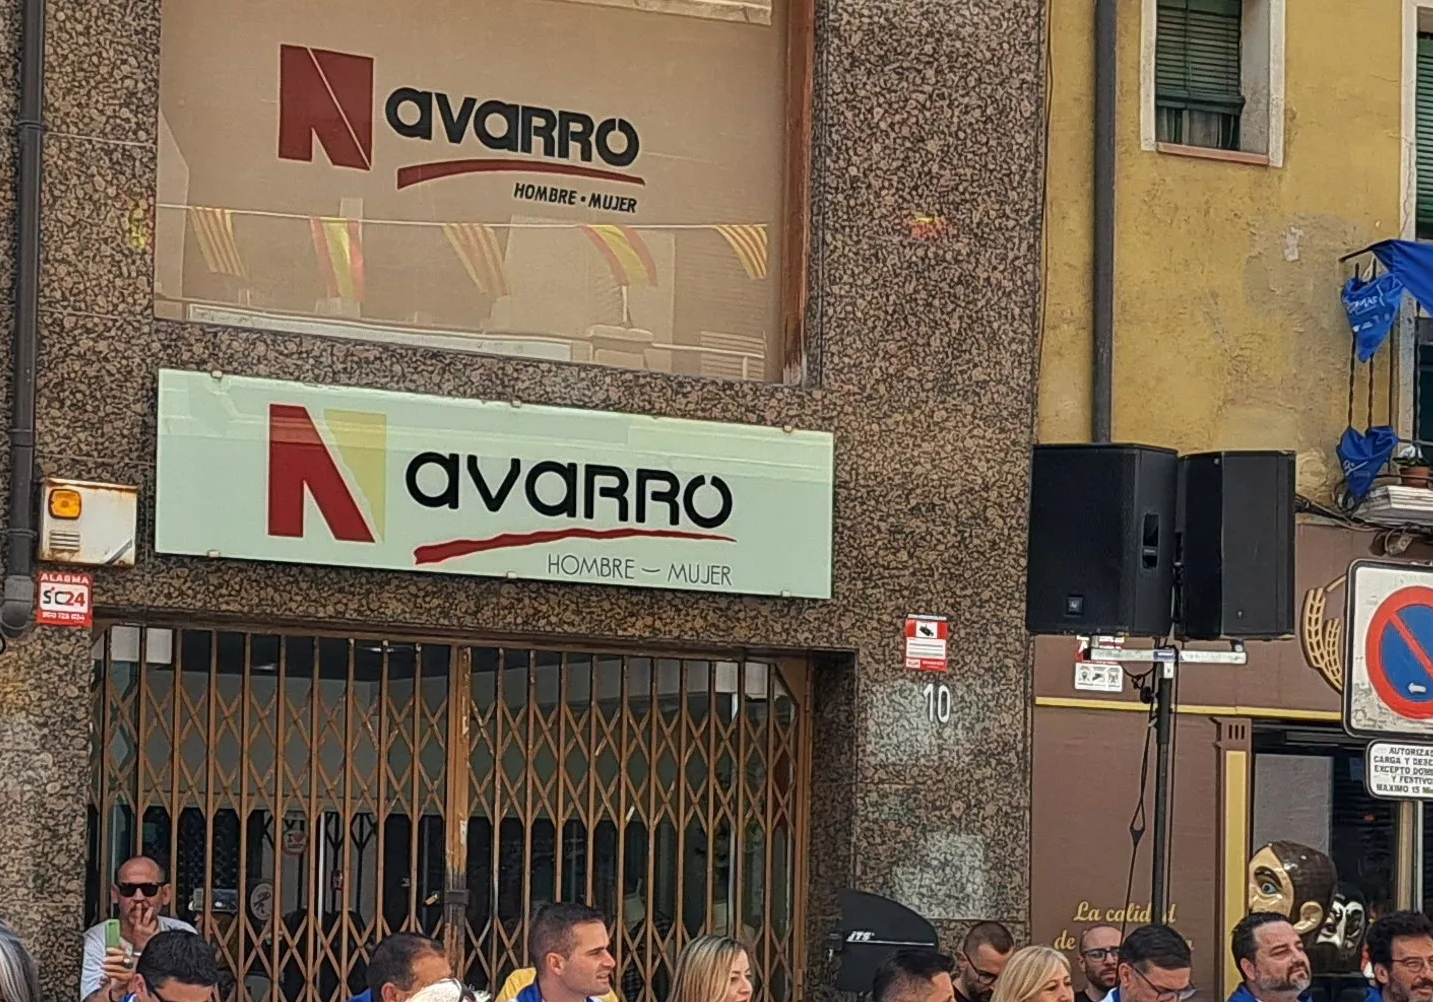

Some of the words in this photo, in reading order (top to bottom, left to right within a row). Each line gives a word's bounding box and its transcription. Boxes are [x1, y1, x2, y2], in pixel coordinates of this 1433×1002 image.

[514, 182, 577, 206] HOMBRE
[589, 193, 637, 213] MUJER
[547, 553, 635, 581] HOMBRE
[667, 562, 733, 587] MUJER
[923, 683, 951, 723] 10
[1373, 756, 1401, 764] CARGA
[1404, 757, 1411, 765] Y
[1374, 765, 1410, 774] EXCEPTO
[1391, 775, 1397, 783] Y
[1073, 901, 1101, 922] La
[1105, 903, 1177, 923] calidd
[1054, 929, 1076, 950] de
